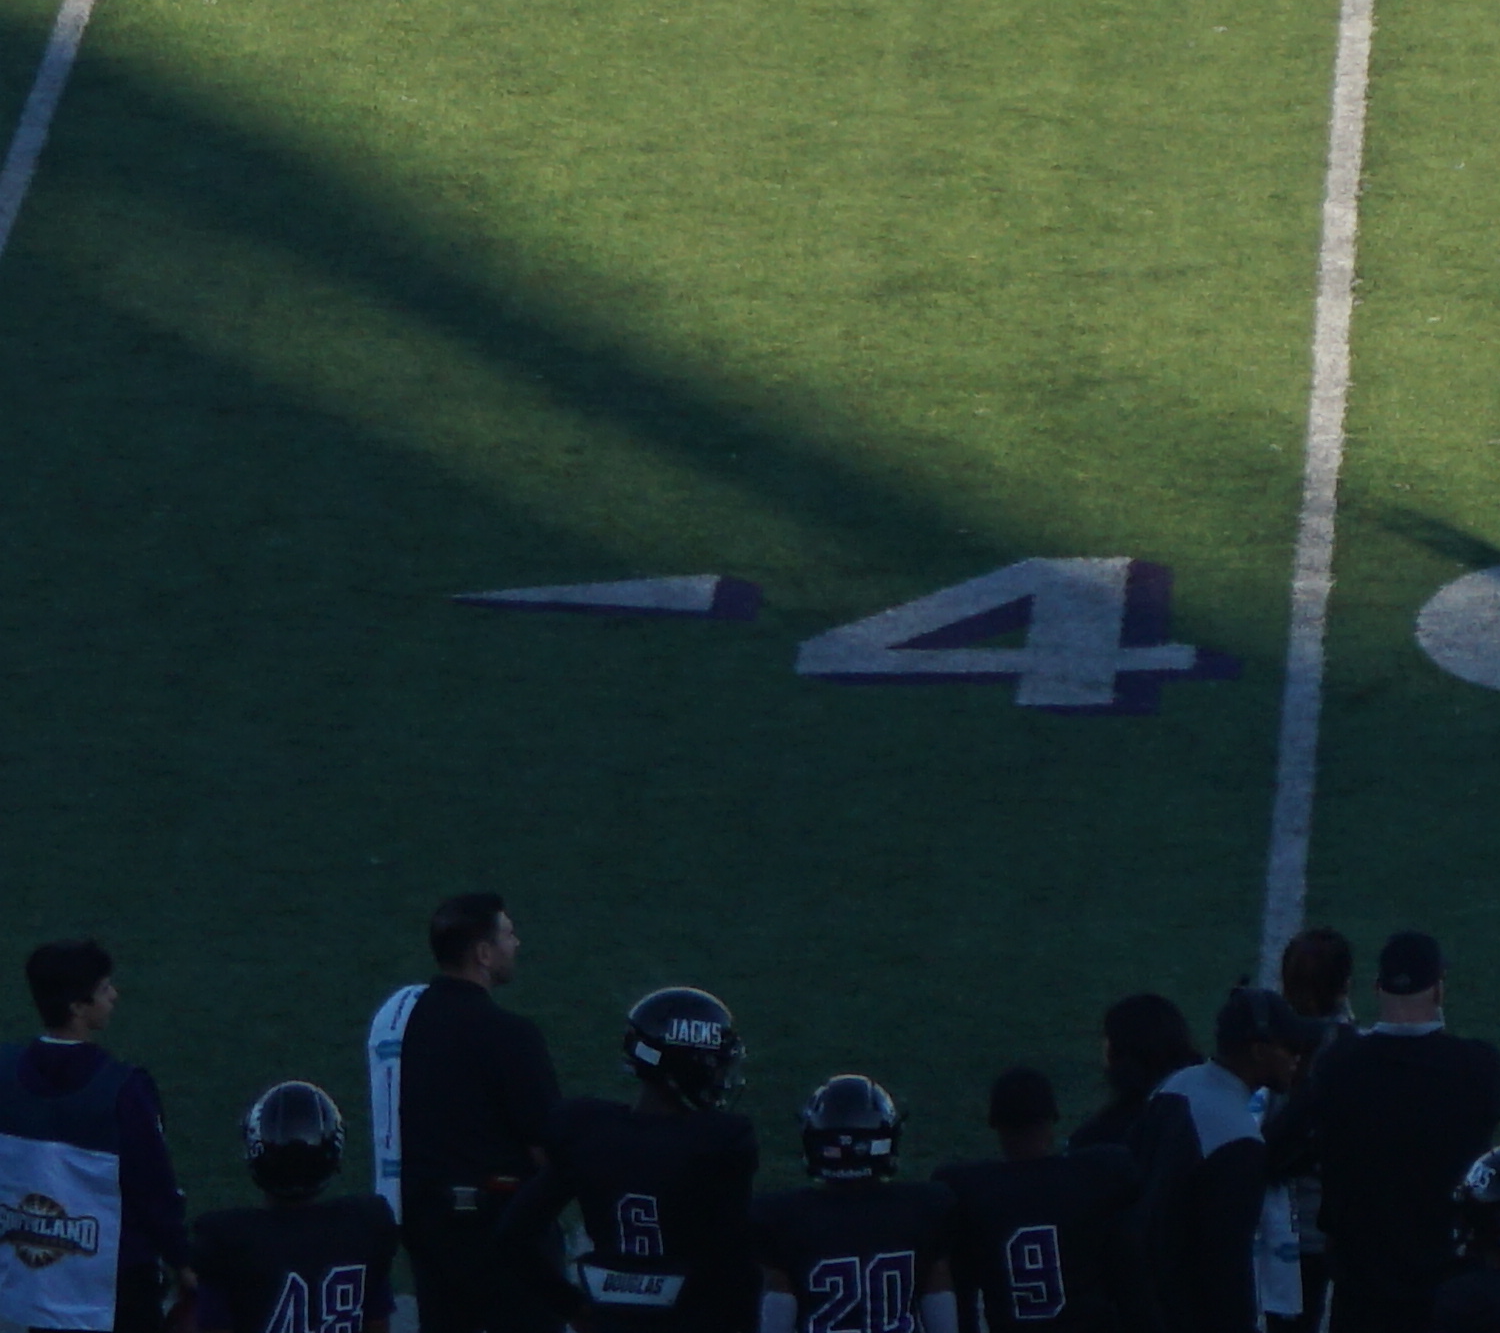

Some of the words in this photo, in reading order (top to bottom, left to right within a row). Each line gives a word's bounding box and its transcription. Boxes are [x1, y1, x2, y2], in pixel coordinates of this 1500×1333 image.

[665, 1018, 722, 1049] JACKS
[618, 1192, 663, 1255] 6
[808, 1249, 915, 1333] 20
[1007, 1225, 1065, 1319] 9
